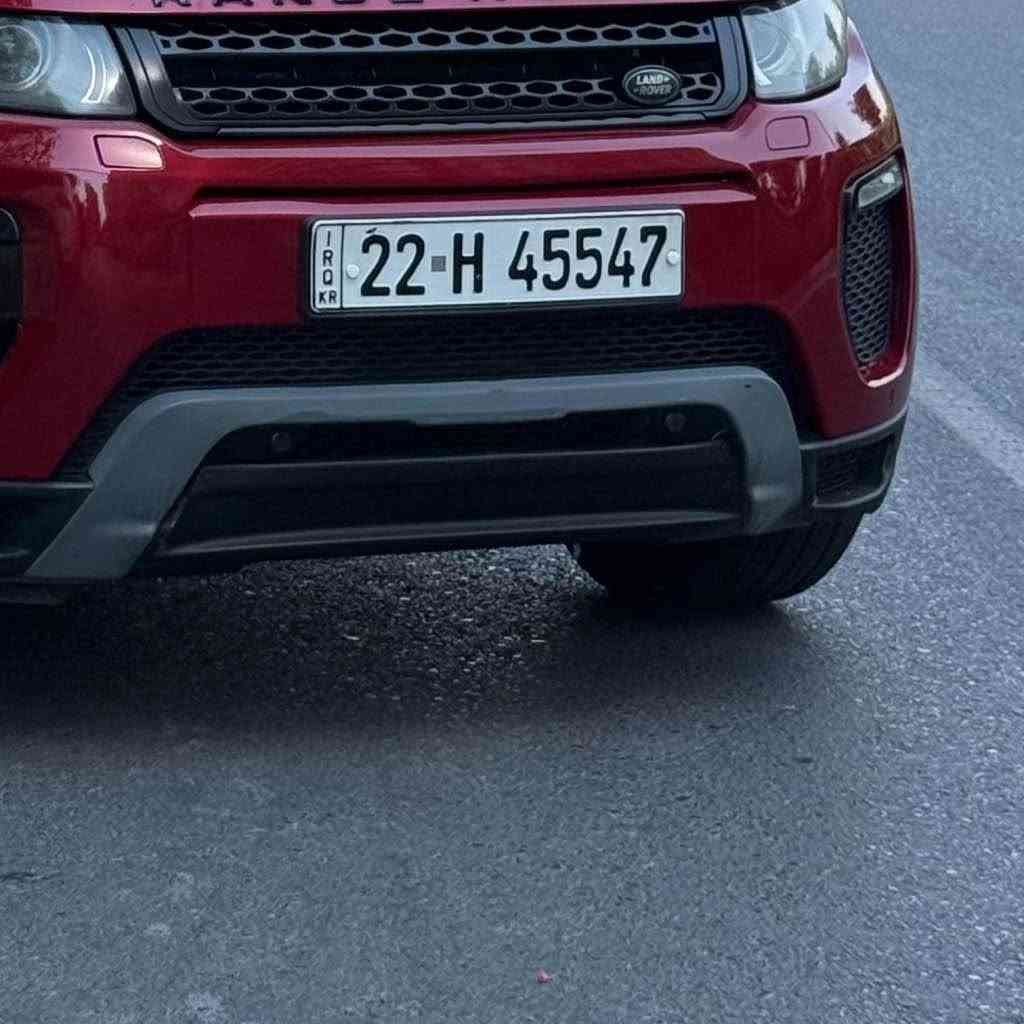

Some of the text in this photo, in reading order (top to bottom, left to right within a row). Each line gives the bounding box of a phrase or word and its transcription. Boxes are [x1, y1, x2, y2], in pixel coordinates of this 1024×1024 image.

[636, 74, 664, 86] LAND
[638, 84, 673, 96] ROVER
[360, 225, 668, 297] 22 H 45547
[319, 290, 337, 305] KR
